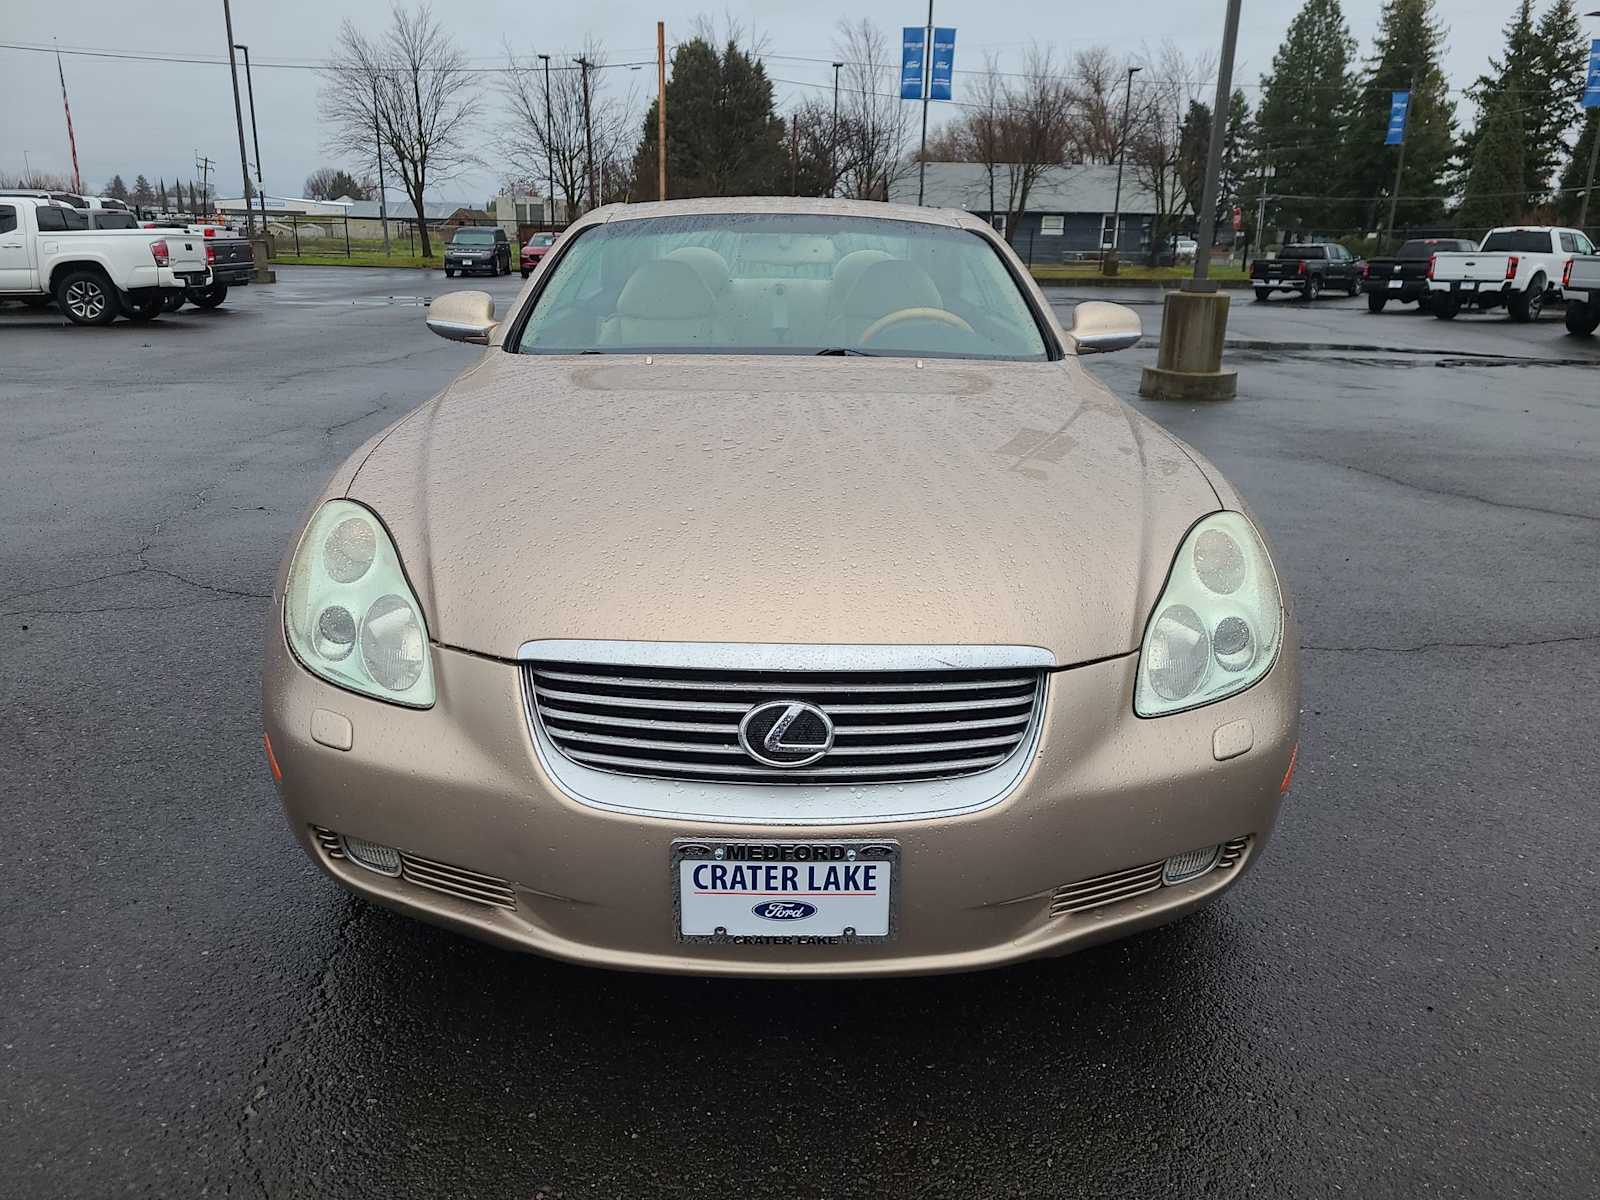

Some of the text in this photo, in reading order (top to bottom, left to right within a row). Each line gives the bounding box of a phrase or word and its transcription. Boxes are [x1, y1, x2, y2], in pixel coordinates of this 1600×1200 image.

[725, 844, 845, 861] MEDFORD
[692, 864, 877, 891] CRATER LAKE
[764, 902, 805, 918] Ford
[733, 935, 839, 945] CRATER LAKE
